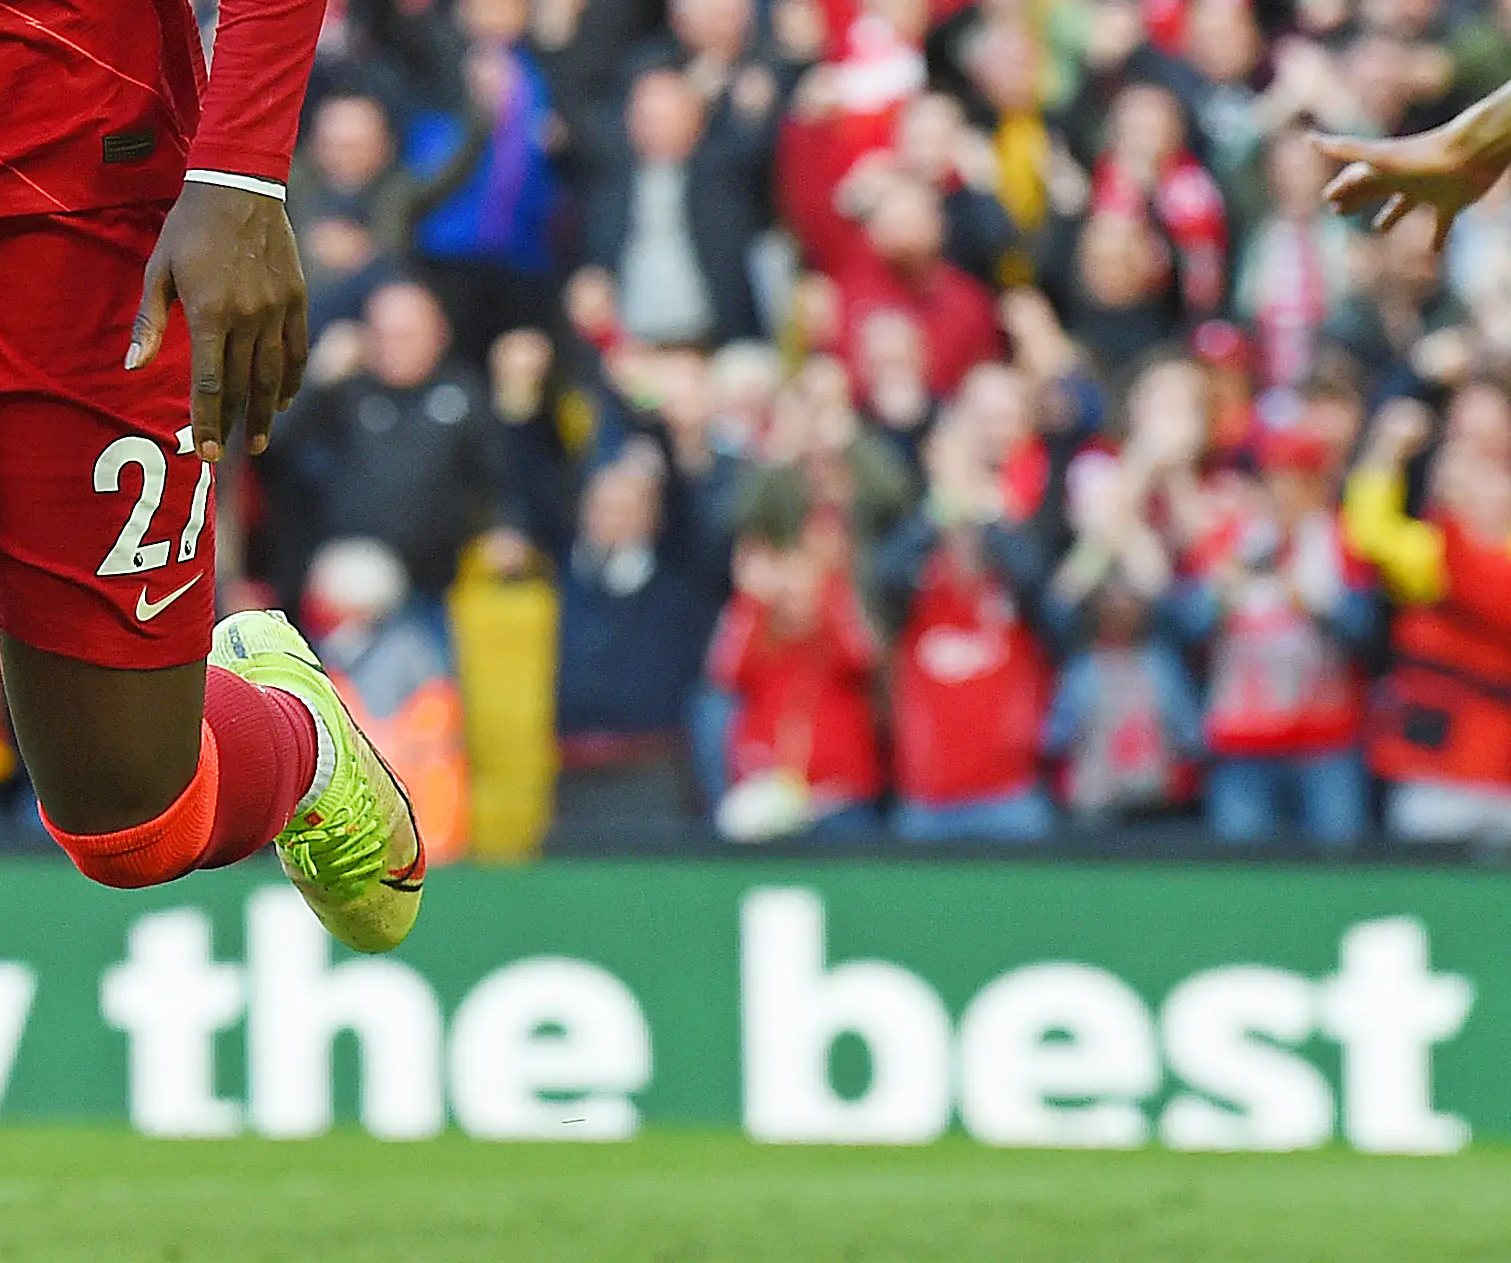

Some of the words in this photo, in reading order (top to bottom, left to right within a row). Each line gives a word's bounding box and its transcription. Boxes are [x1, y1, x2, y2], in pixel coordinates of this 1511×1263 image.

[93, 425, 211, 576] 27
[100, 886, 652, 1141] the
[739, 886, 1475, 1155] best
